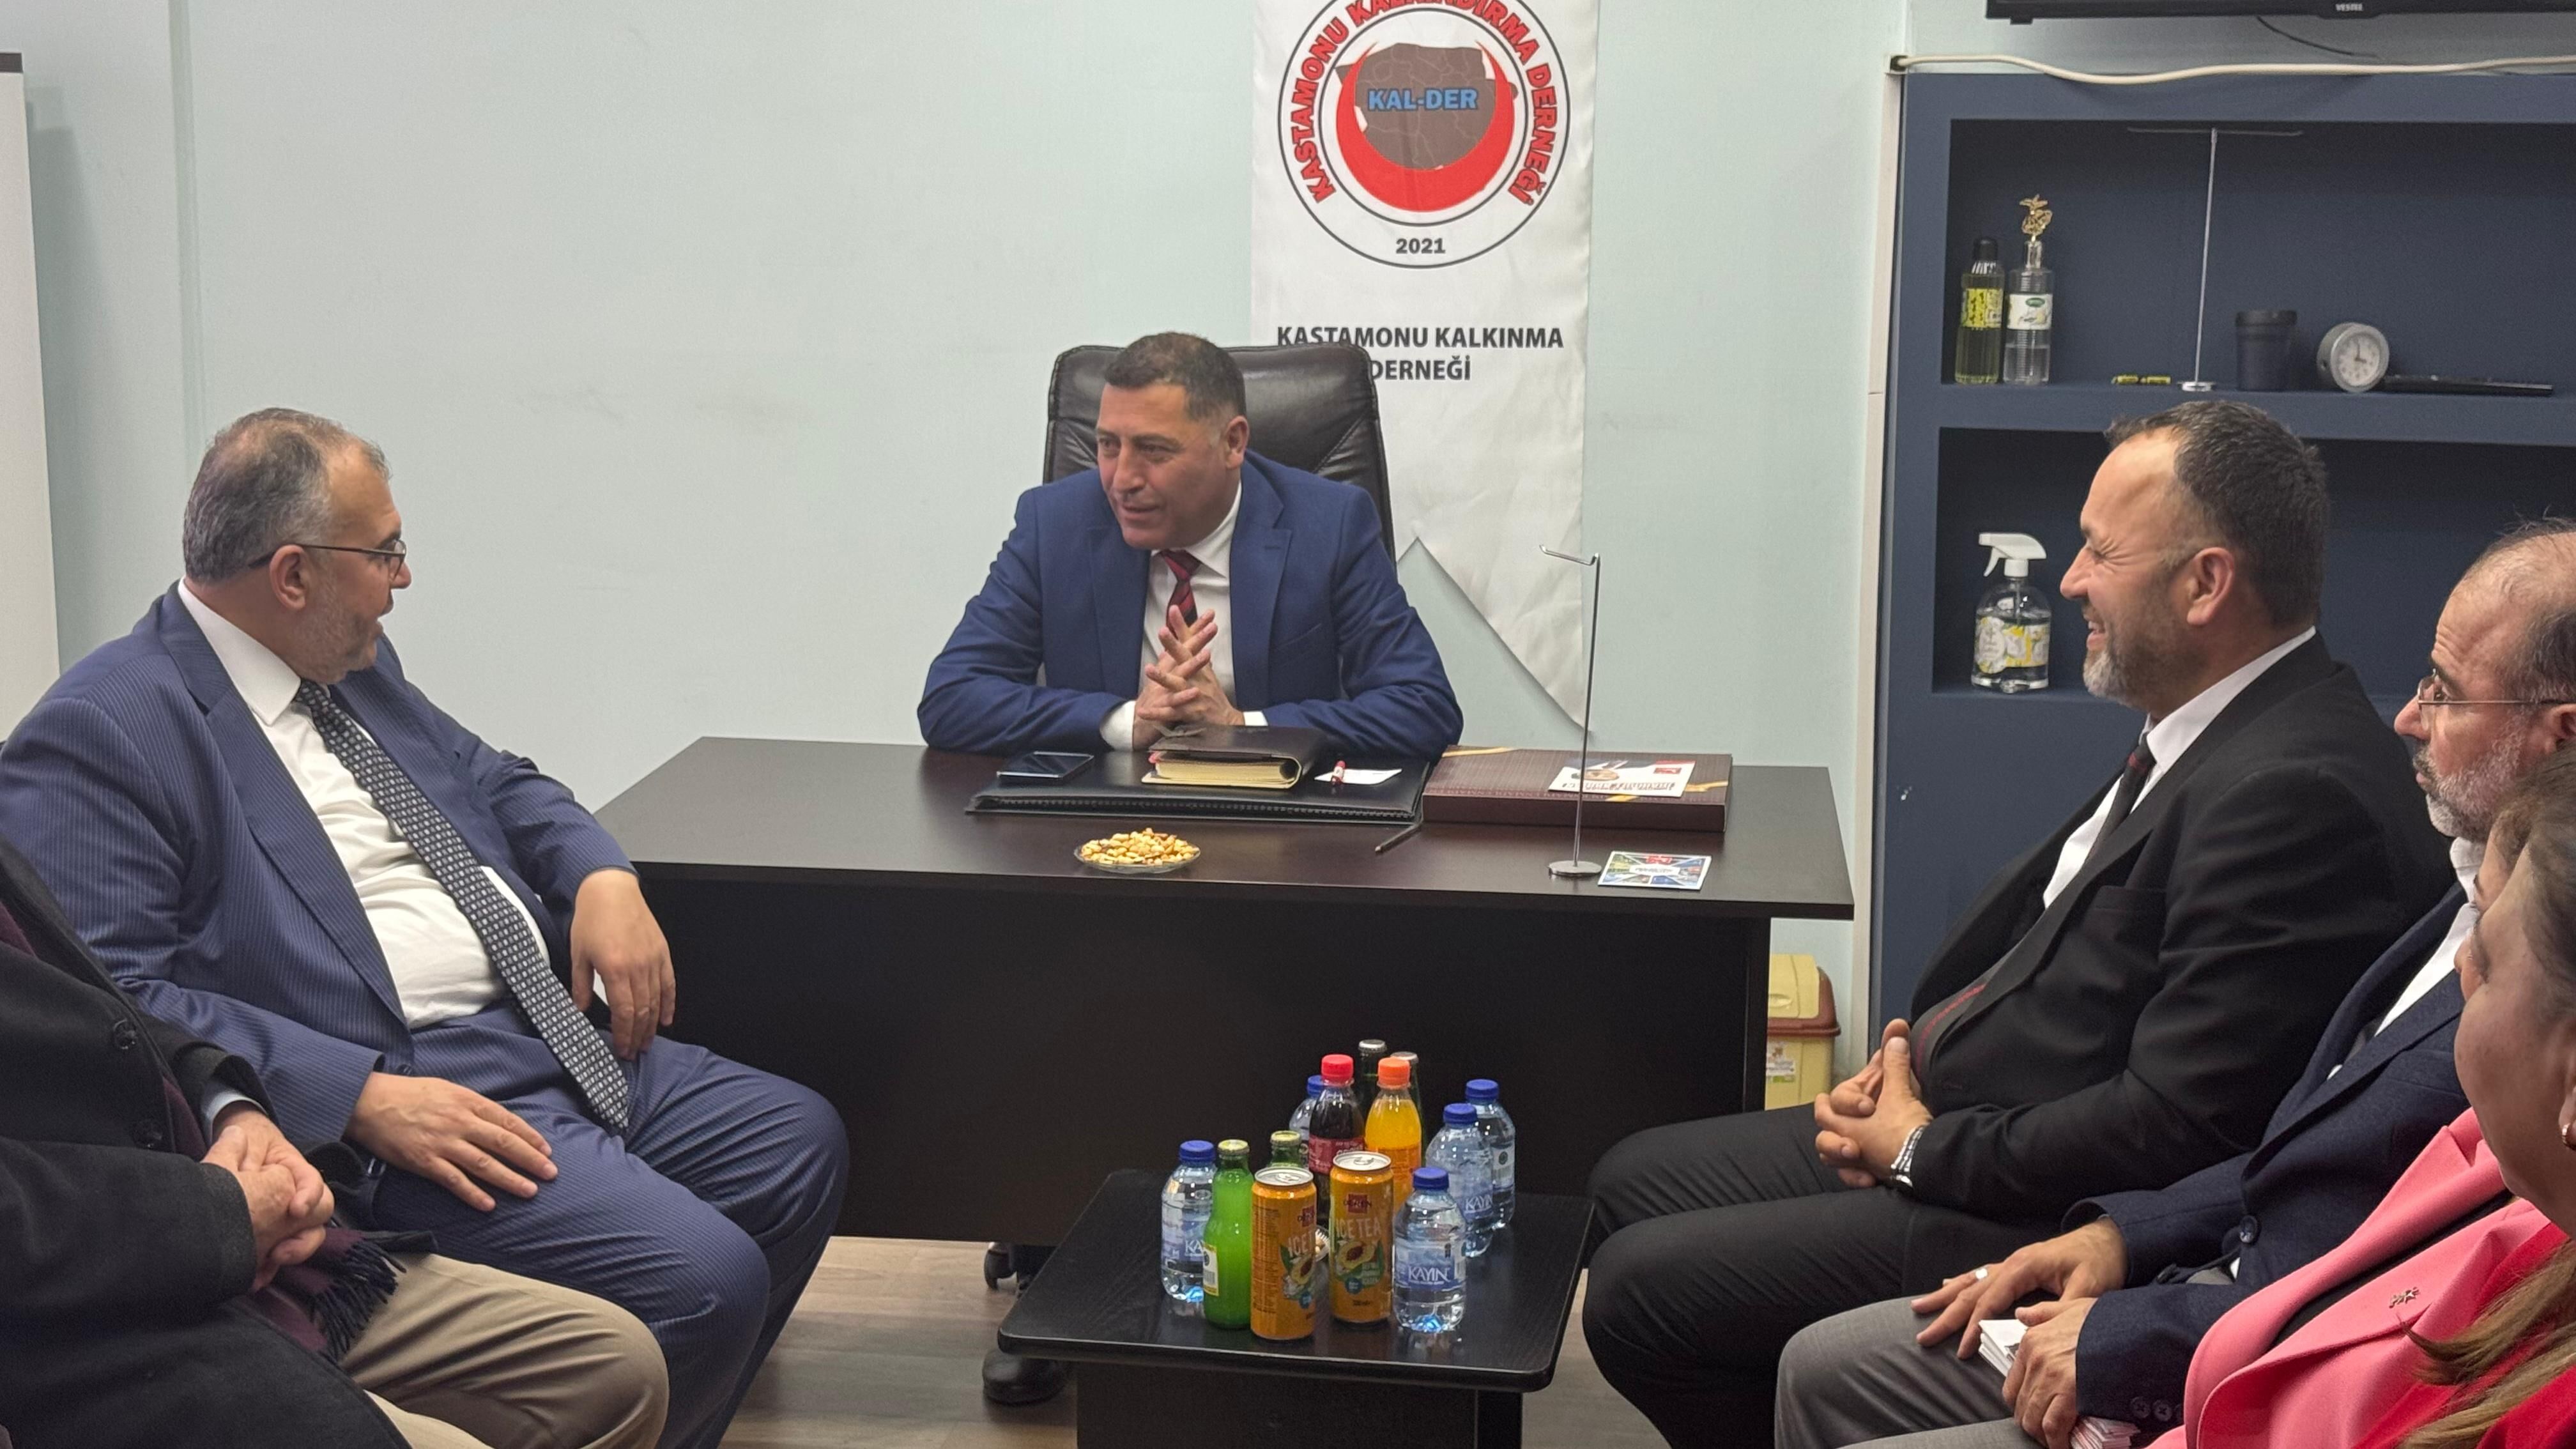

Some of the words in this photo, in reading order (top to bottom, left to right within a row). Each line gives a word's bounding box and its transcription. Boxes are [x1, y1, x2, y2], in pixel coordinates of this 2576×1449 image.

[1368, 88, 1478, 111] KAL-DER
[1291, 16, 1349, 203] KASTAMONU
[1508, 63, 1558, 206] DERNEĞİ
[1396, 238, 1446, 254] 2021
[1277, 326, 1429, 348] KASTAMONU
[1435, 327, 1565, 348] KALKINMA
[1370, 355, 1471, 380] DERNEĞİ
[1358, 1216, 1382, 1237] TEA
[1407, 1266, 1452, 1283] KAYIN
